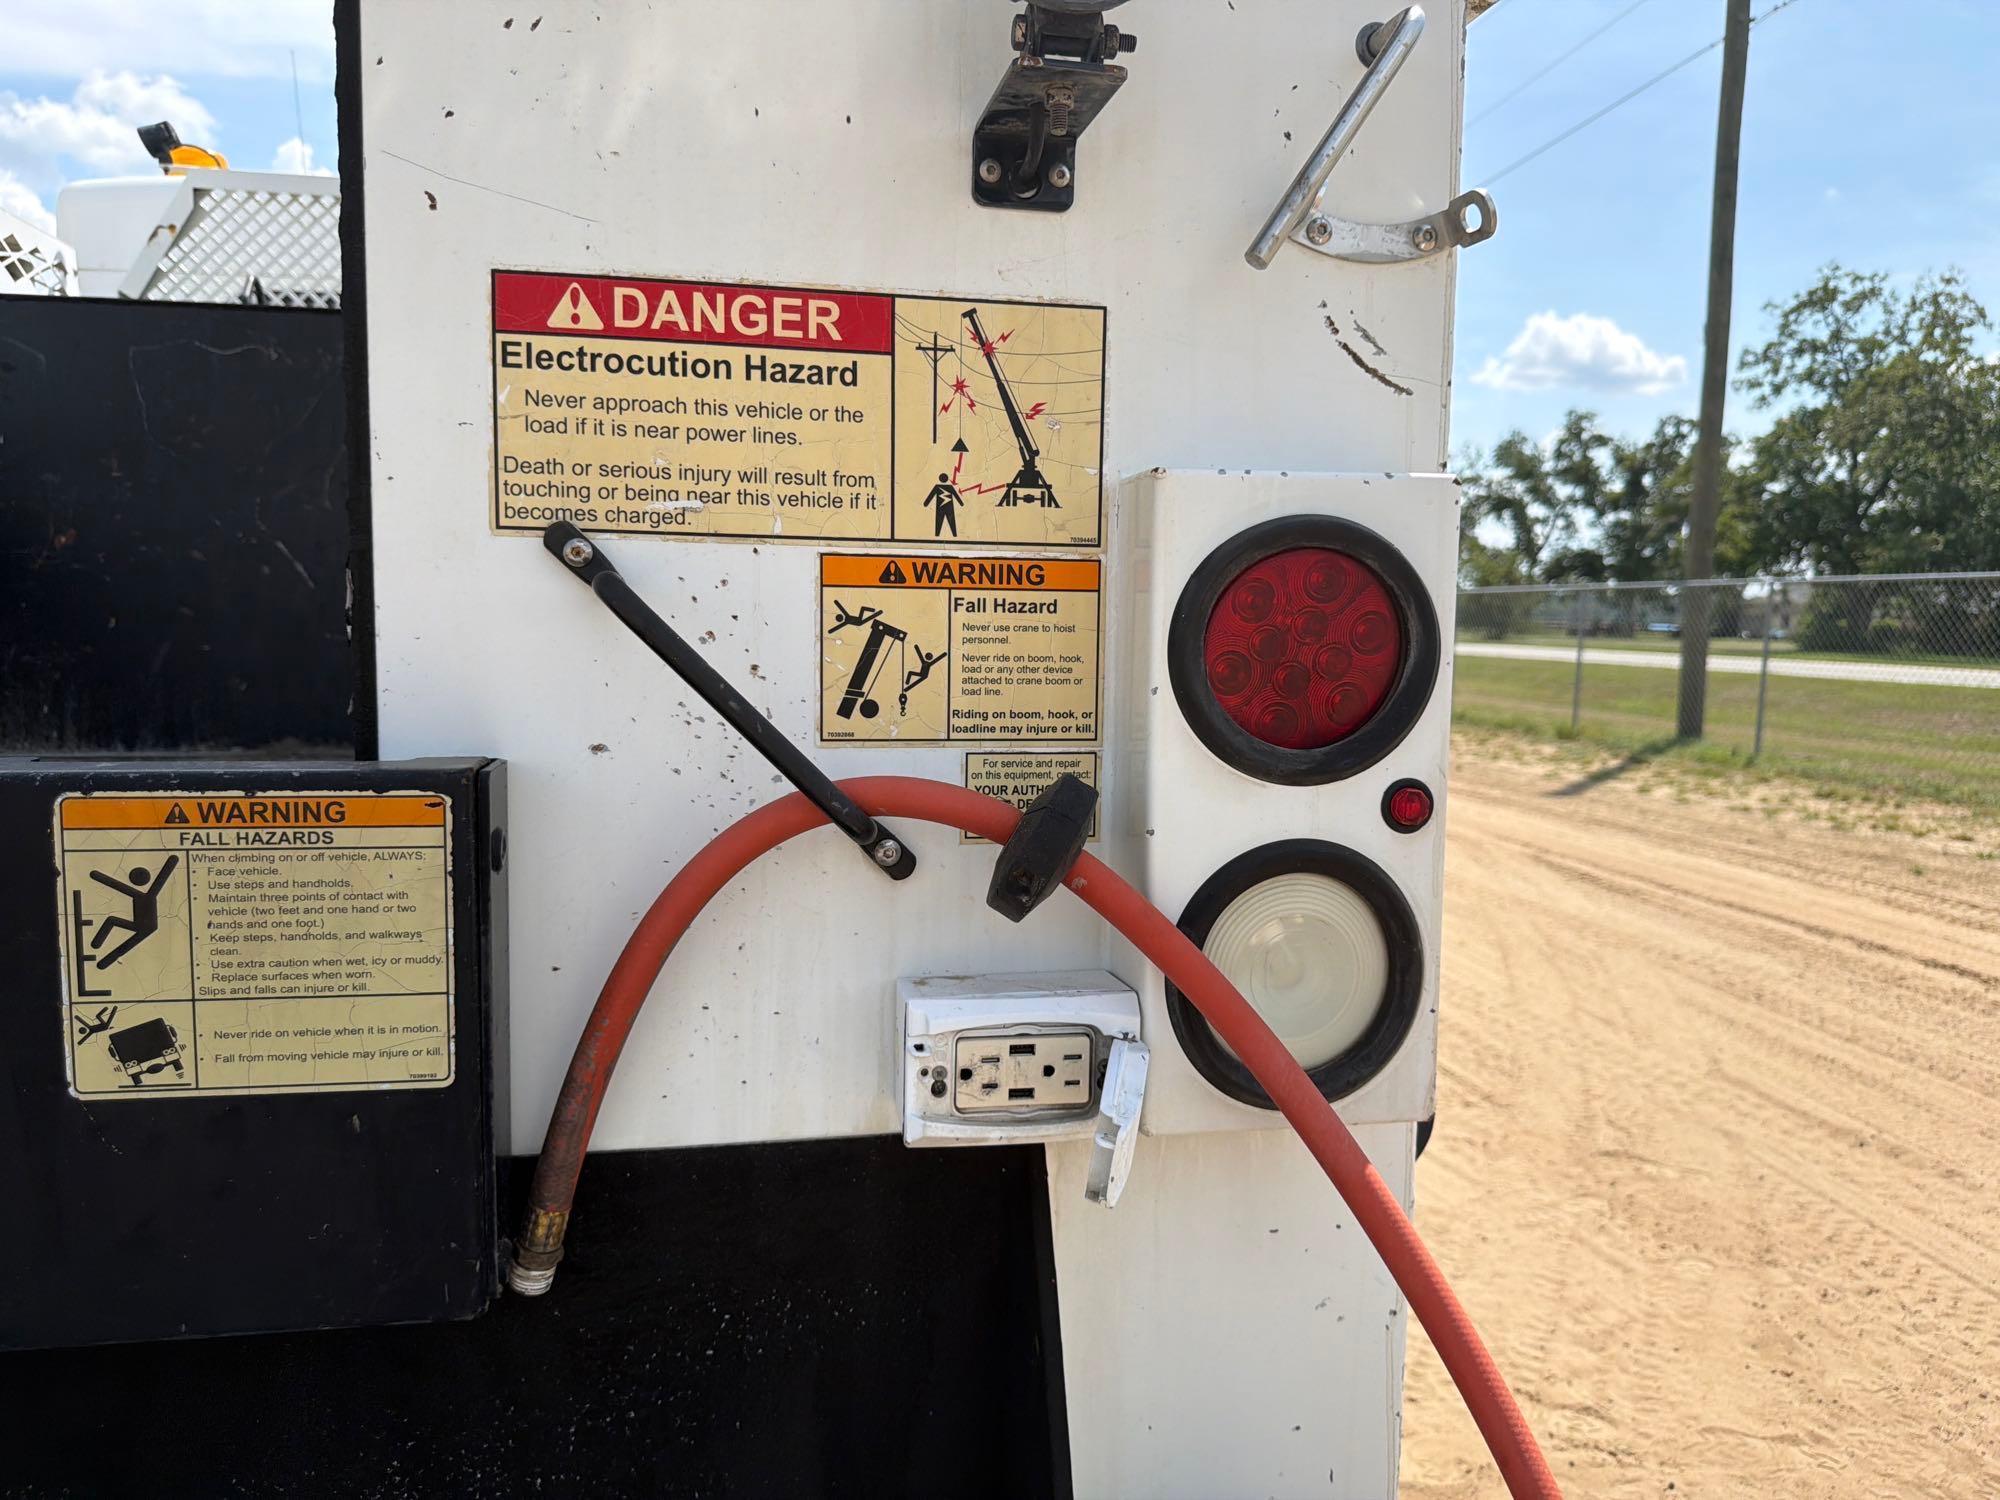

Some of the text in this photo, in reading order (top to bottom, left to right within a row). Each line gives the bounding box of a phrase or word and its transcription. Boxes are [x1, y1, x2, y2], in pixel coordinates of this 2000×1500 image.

[613, 286, 843, 341] DANGER
[500, 340, 858, 387] Electrocution Hazard
[524, 388, 864, 424] Never approach this vehicle or the
[524, 415, 803, 446] load if it is near power lines.
[503, 455, 875, 488] Death or serious injury will result from
[503, 479, 877, 511] touching or being near this vehicle if it
[504, 502, 692, 529] becomes charged.
[911, 561, 1046, 587] WARNING
[953, 597, 1058, 615] Fall Hazard
[962, 622, 1076, 633] Never use crane to hoist
[961, 635, 1012, 646] personnel.
[961, 653, 1085, 665] Never ride on boom, hook,
[961, 664, 1073, 677] load or any other device
[961, 676, 1084, 686] attached to crane boom or
[961, 687, 1004, 697] load line.
[952, 709, 1094, 722] Riding on boom, hook, or
[951, 723, 1095, 736] loadline may injure or kill.
[982, 758, 1082, 770] For service and repair
[970, 771, 983, 780] on
[985, 770, 1002, 780] this
[1003, 770, 1054, 782] equipment,
[197, 801, 346, 824] WARNING
[179, 830, 334, 847] FALL HAZARDS
[191, 850, 427, 866] When climbing on or off vehicle, ALWAYS:
[207, 866, 282, 876] Face vehicle.
[207, 878, 354, 892] Use steps and handholds.
[208, 890, 409, 904] Maintain three points of contact with
[207, 903, 417, 918] vehicle (two feet and one hand or two
[207, 920, 244, 930] hands
[246, 919, 268, 929] and
[271, 920, 292, 929] one
[208, 929, 423, 945] Keep steps, handholds, and walkways
[209, 946, 242, 956] clean.
[210, 954, 444, 969] Use extra caution when wet, icy or muddy.
[211, 970, 376, 984] Replace surfaces when worn.
[199, 982, 371, 997] Slips and falls can injure or kill.
[213, 1024, 443, 1041] Never ride on vehicle when it is in motion.
[214, 1047, 444, 1064] Fall from moving vehicle may injure or kill.
